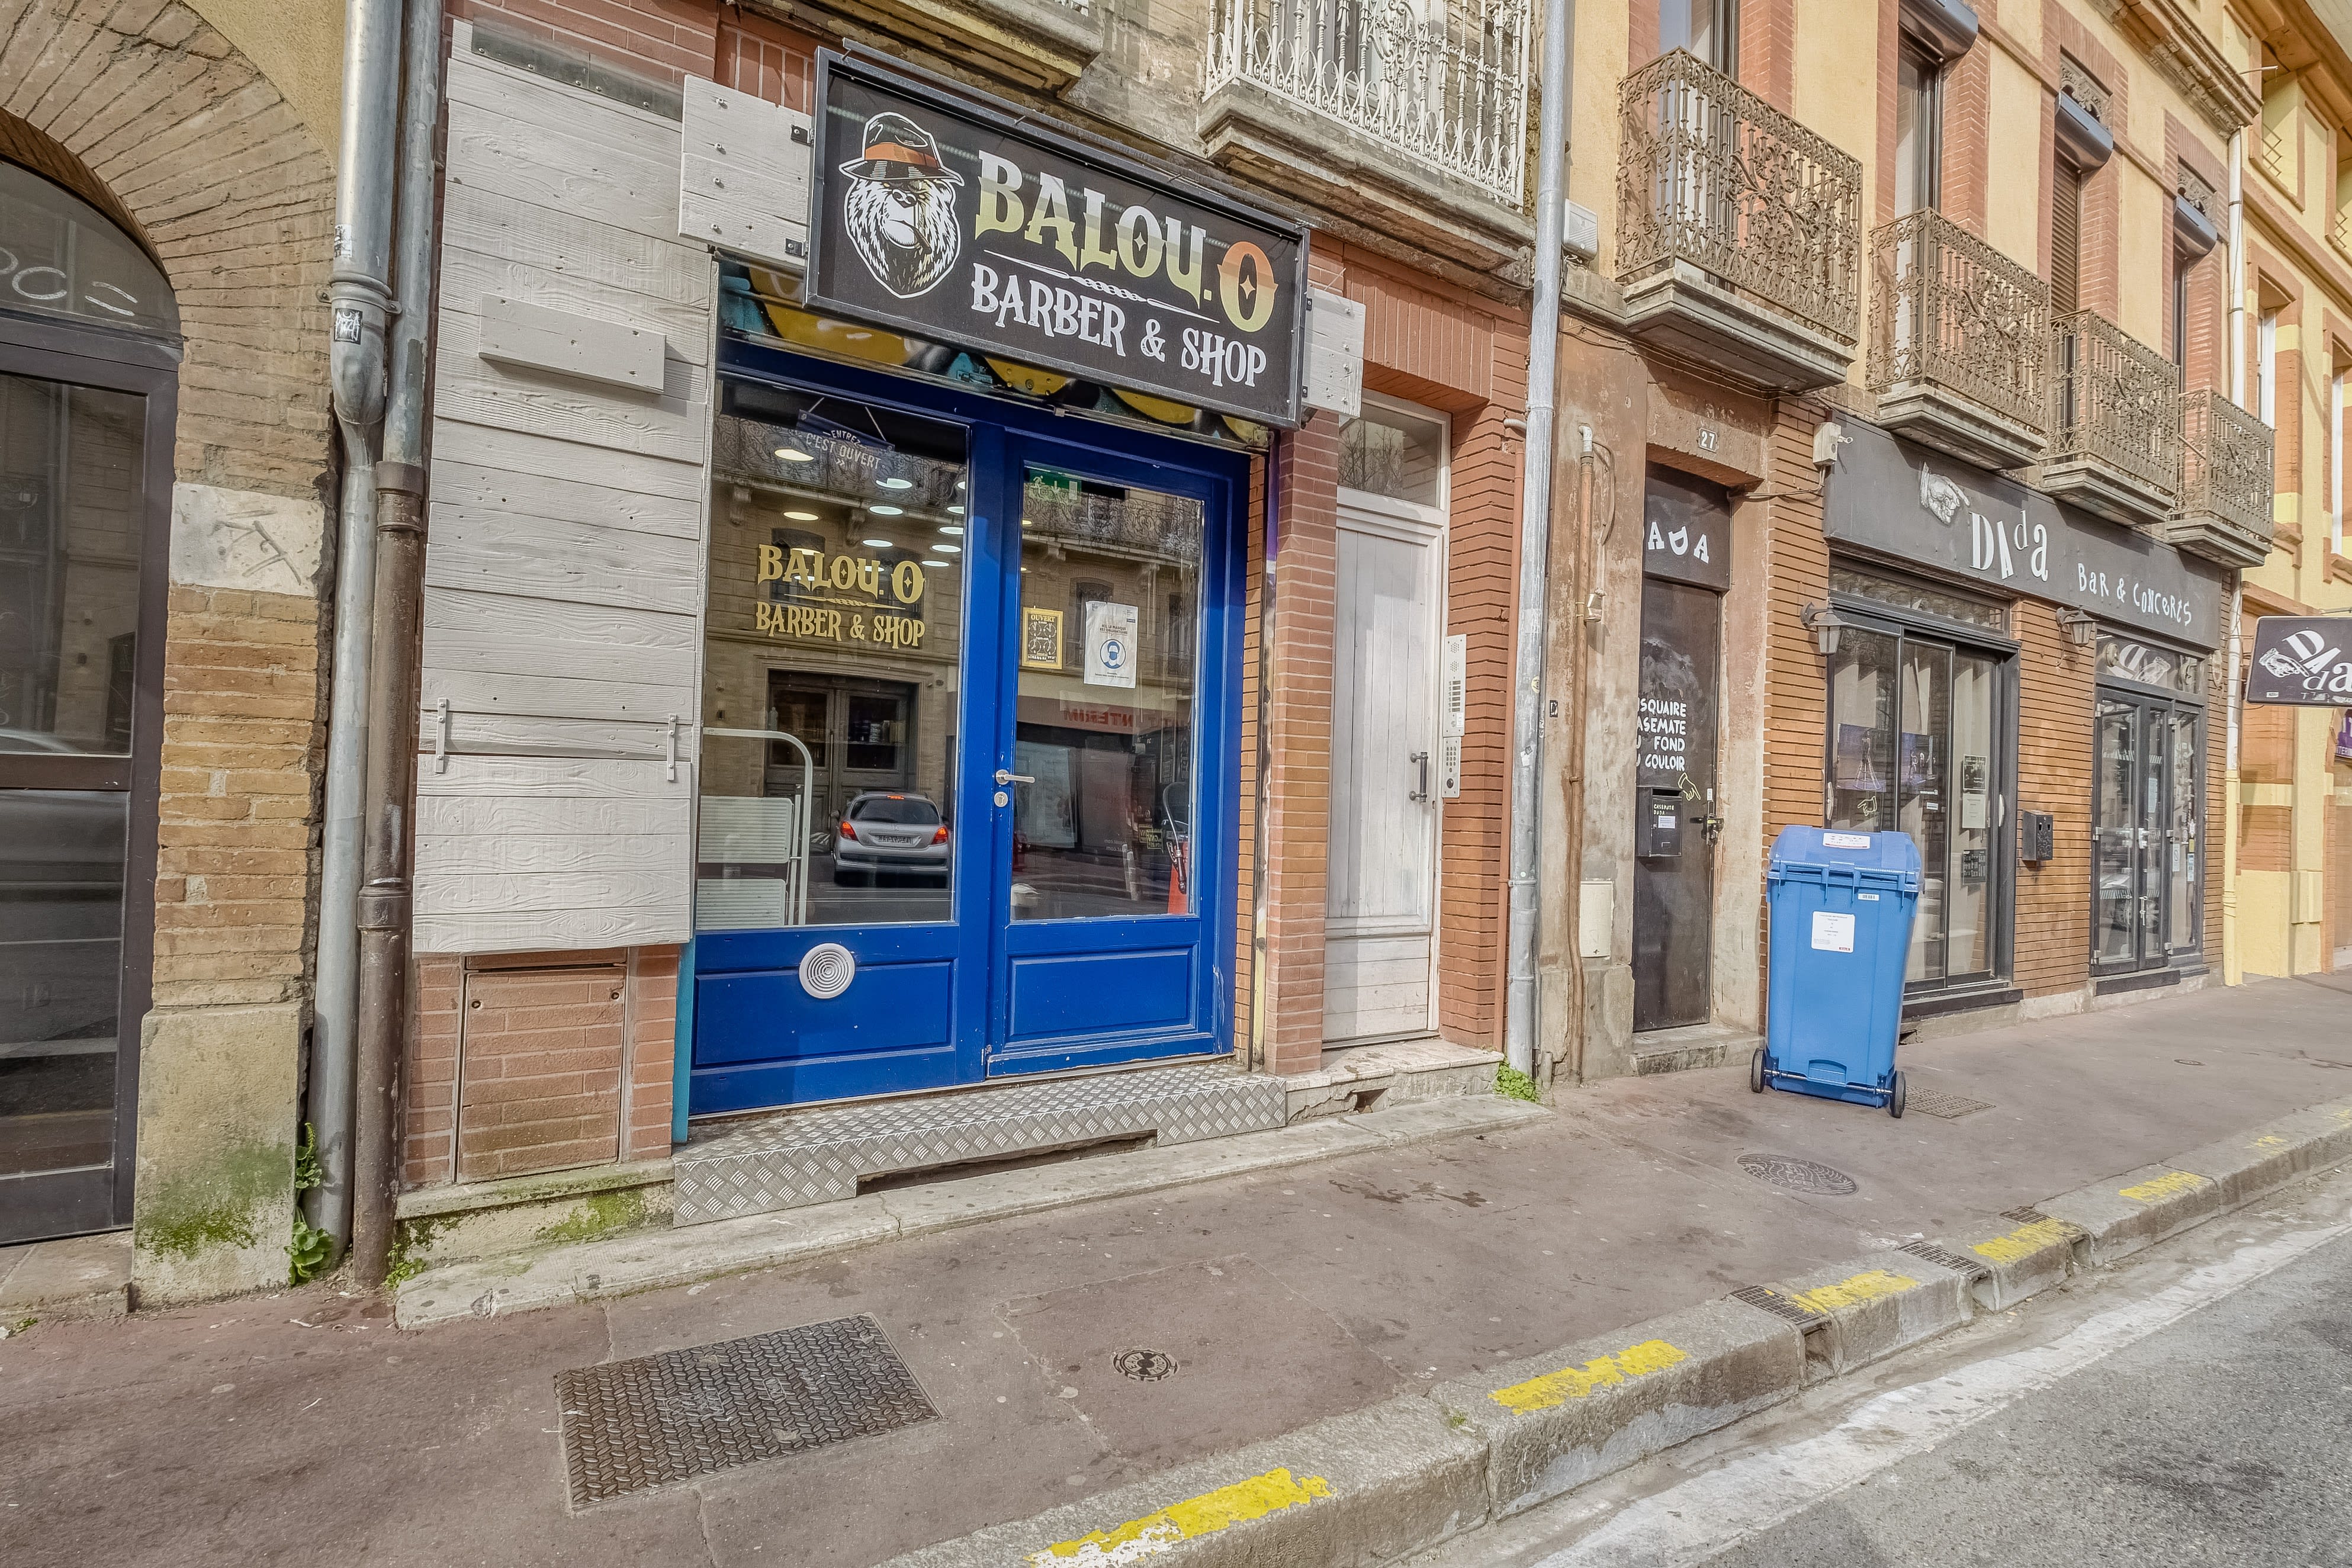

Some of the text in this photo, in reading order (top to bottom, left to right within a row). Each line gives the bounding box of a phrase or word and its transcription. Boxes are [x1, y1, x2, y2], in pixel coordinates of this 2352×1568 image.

[971, 262, 1267, 387] BARBER & SHOP
[831, 430, 861, 446] ENTREZ
[1701, 431, 1715, 449] 27
[806, 433, 881, 469] C'EST OUVERT
[1643, 522, 1710, 564] ADA
[2116, 577, 2126, 603] &
[756, 602, 925, 649] BARBER & SHOP
[1637, 698, 1687, 717] SQUAIRE
[1637, 716, 1686, 735] ASEMATE
[1654, 736, 1686, 751] FOND
[1645, 753, 1685, 772] COULOIR
